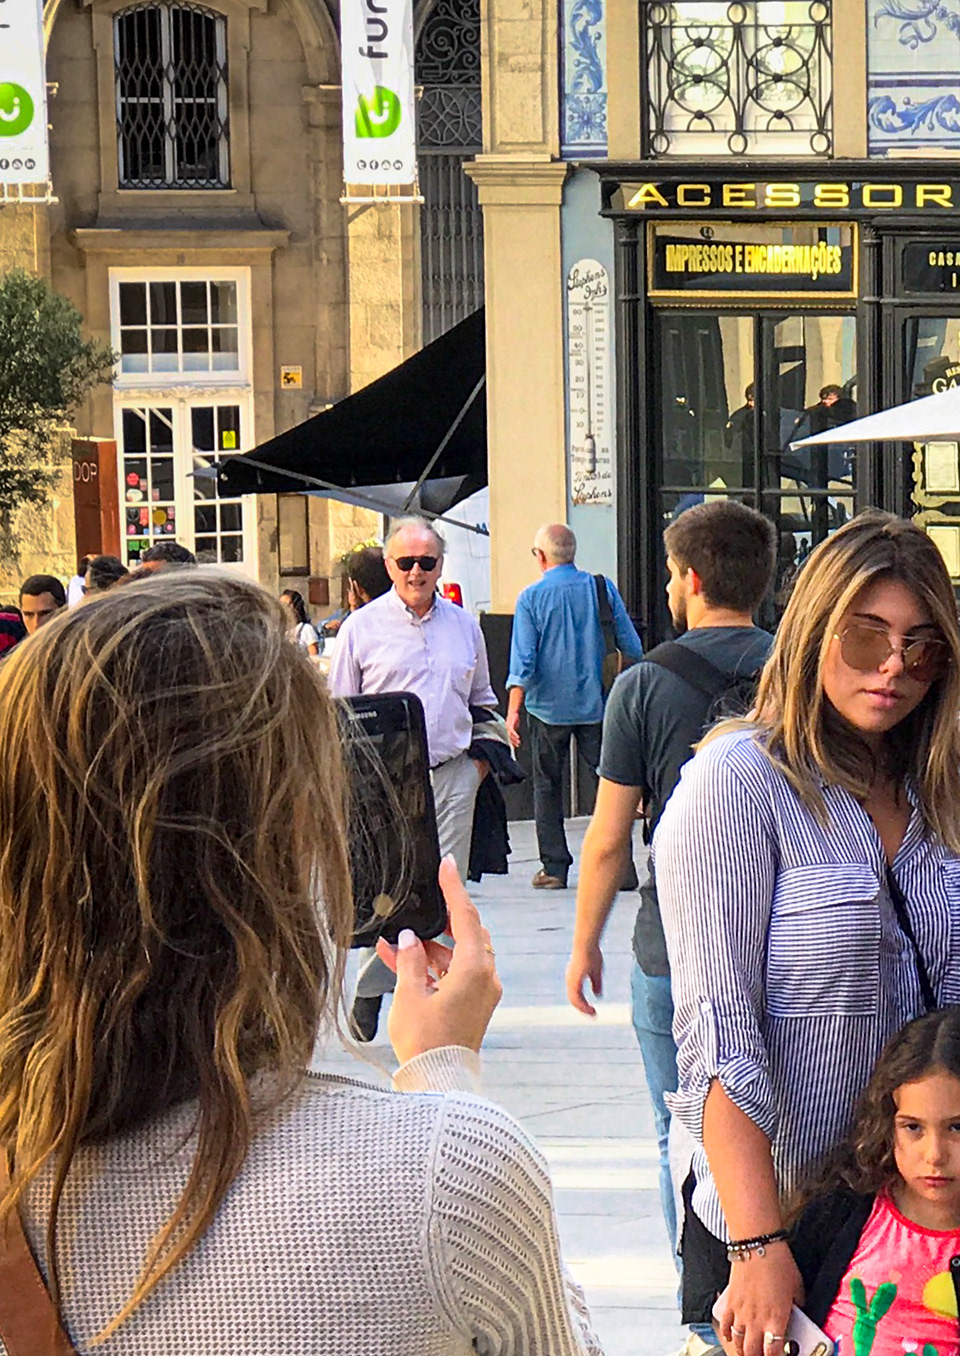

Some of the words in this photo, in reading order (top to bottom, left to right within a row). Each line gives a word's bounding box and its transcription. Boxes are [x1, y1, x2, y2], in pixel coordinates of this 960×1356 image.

[665, 244, 733, 273] IMPRESSOS
[735, 245, 743, 273] E
[744, 241, 842, 280] ENCADERNAÇÕES
[73, 461, 98, 482] DOP
